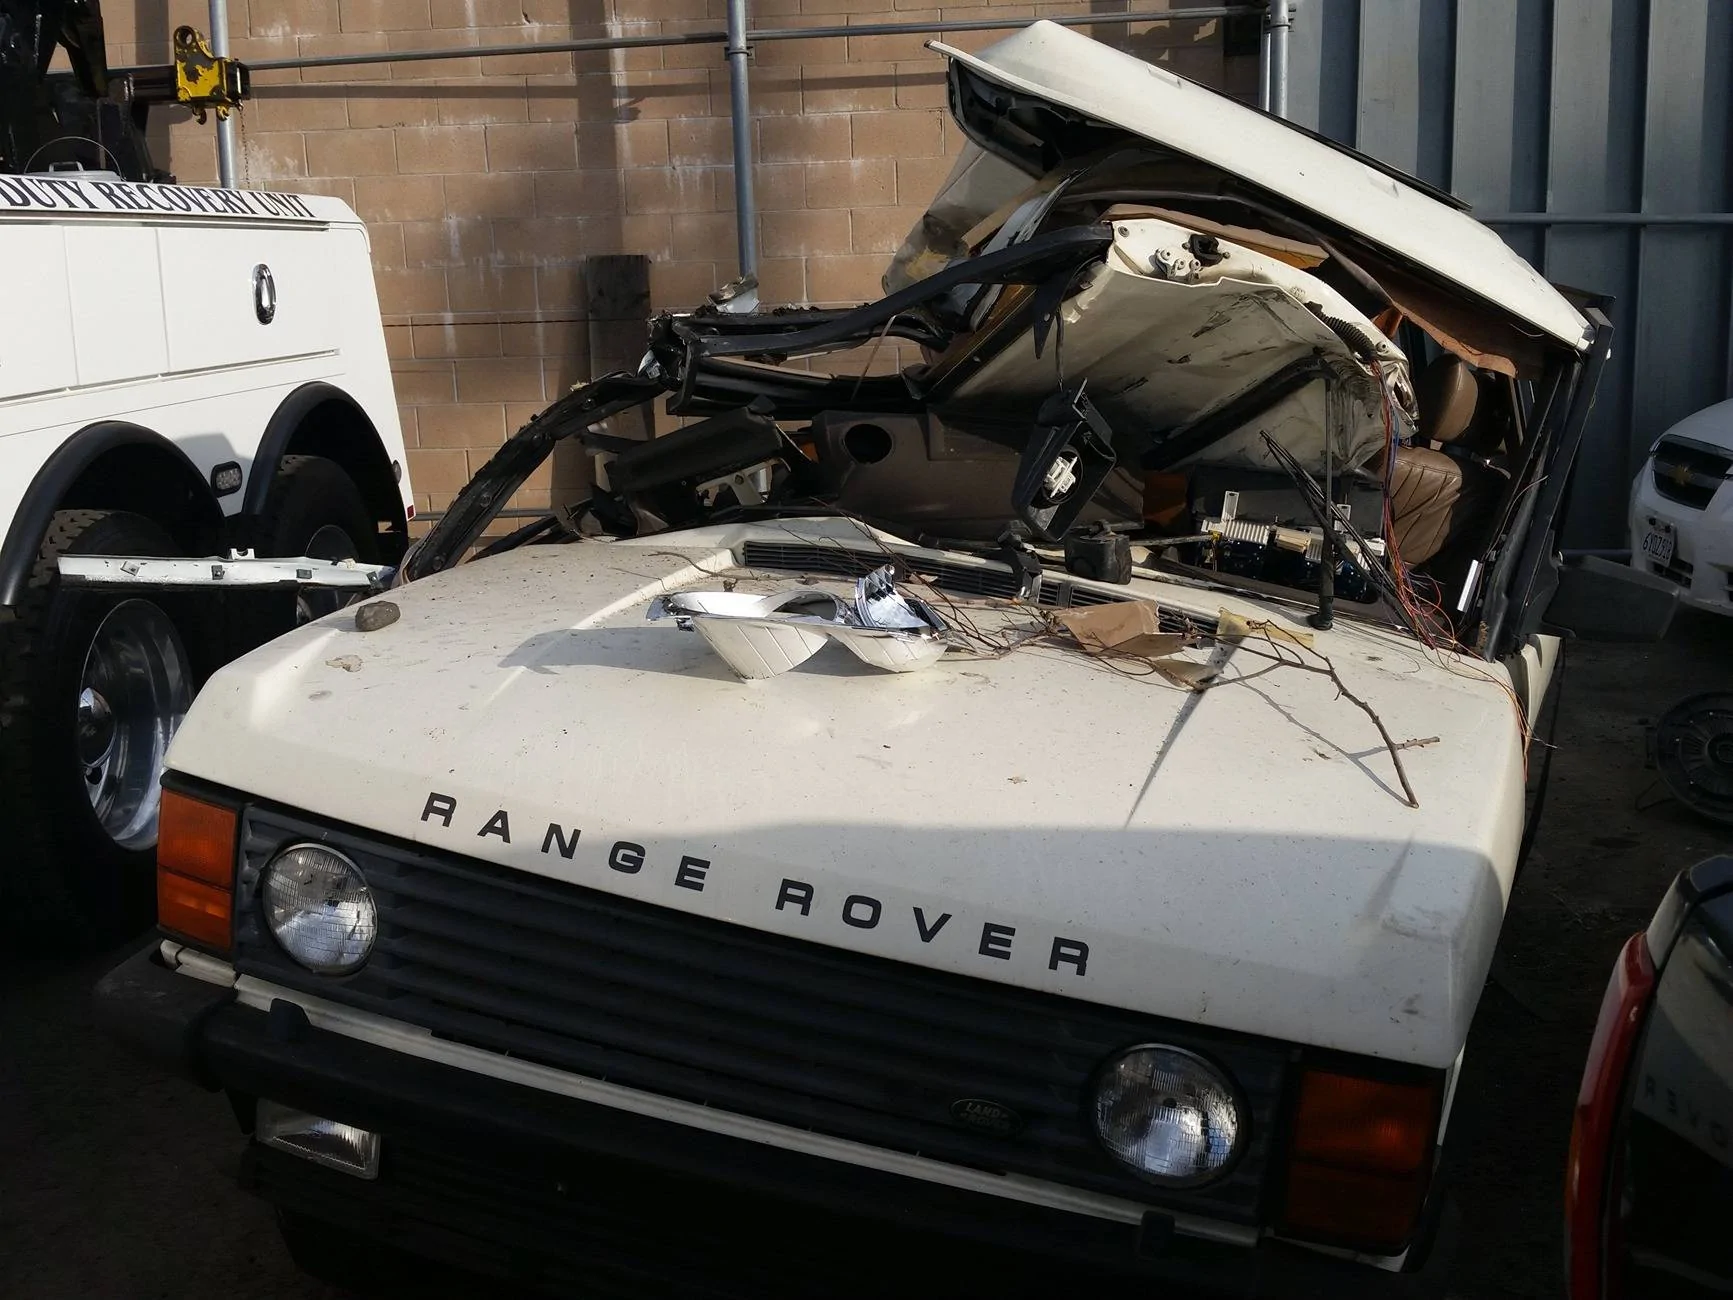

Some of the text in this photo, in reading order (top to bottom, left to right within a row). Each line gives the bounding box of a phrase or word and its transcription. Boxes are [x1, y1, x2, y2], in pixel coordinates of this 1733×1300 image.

[0, 177, 316, 218] DUTY RECOVERY UNIT
[420, 791, 1090, 977] RANGE ROVER
[965, 1102, 1001, 1118] LAND
